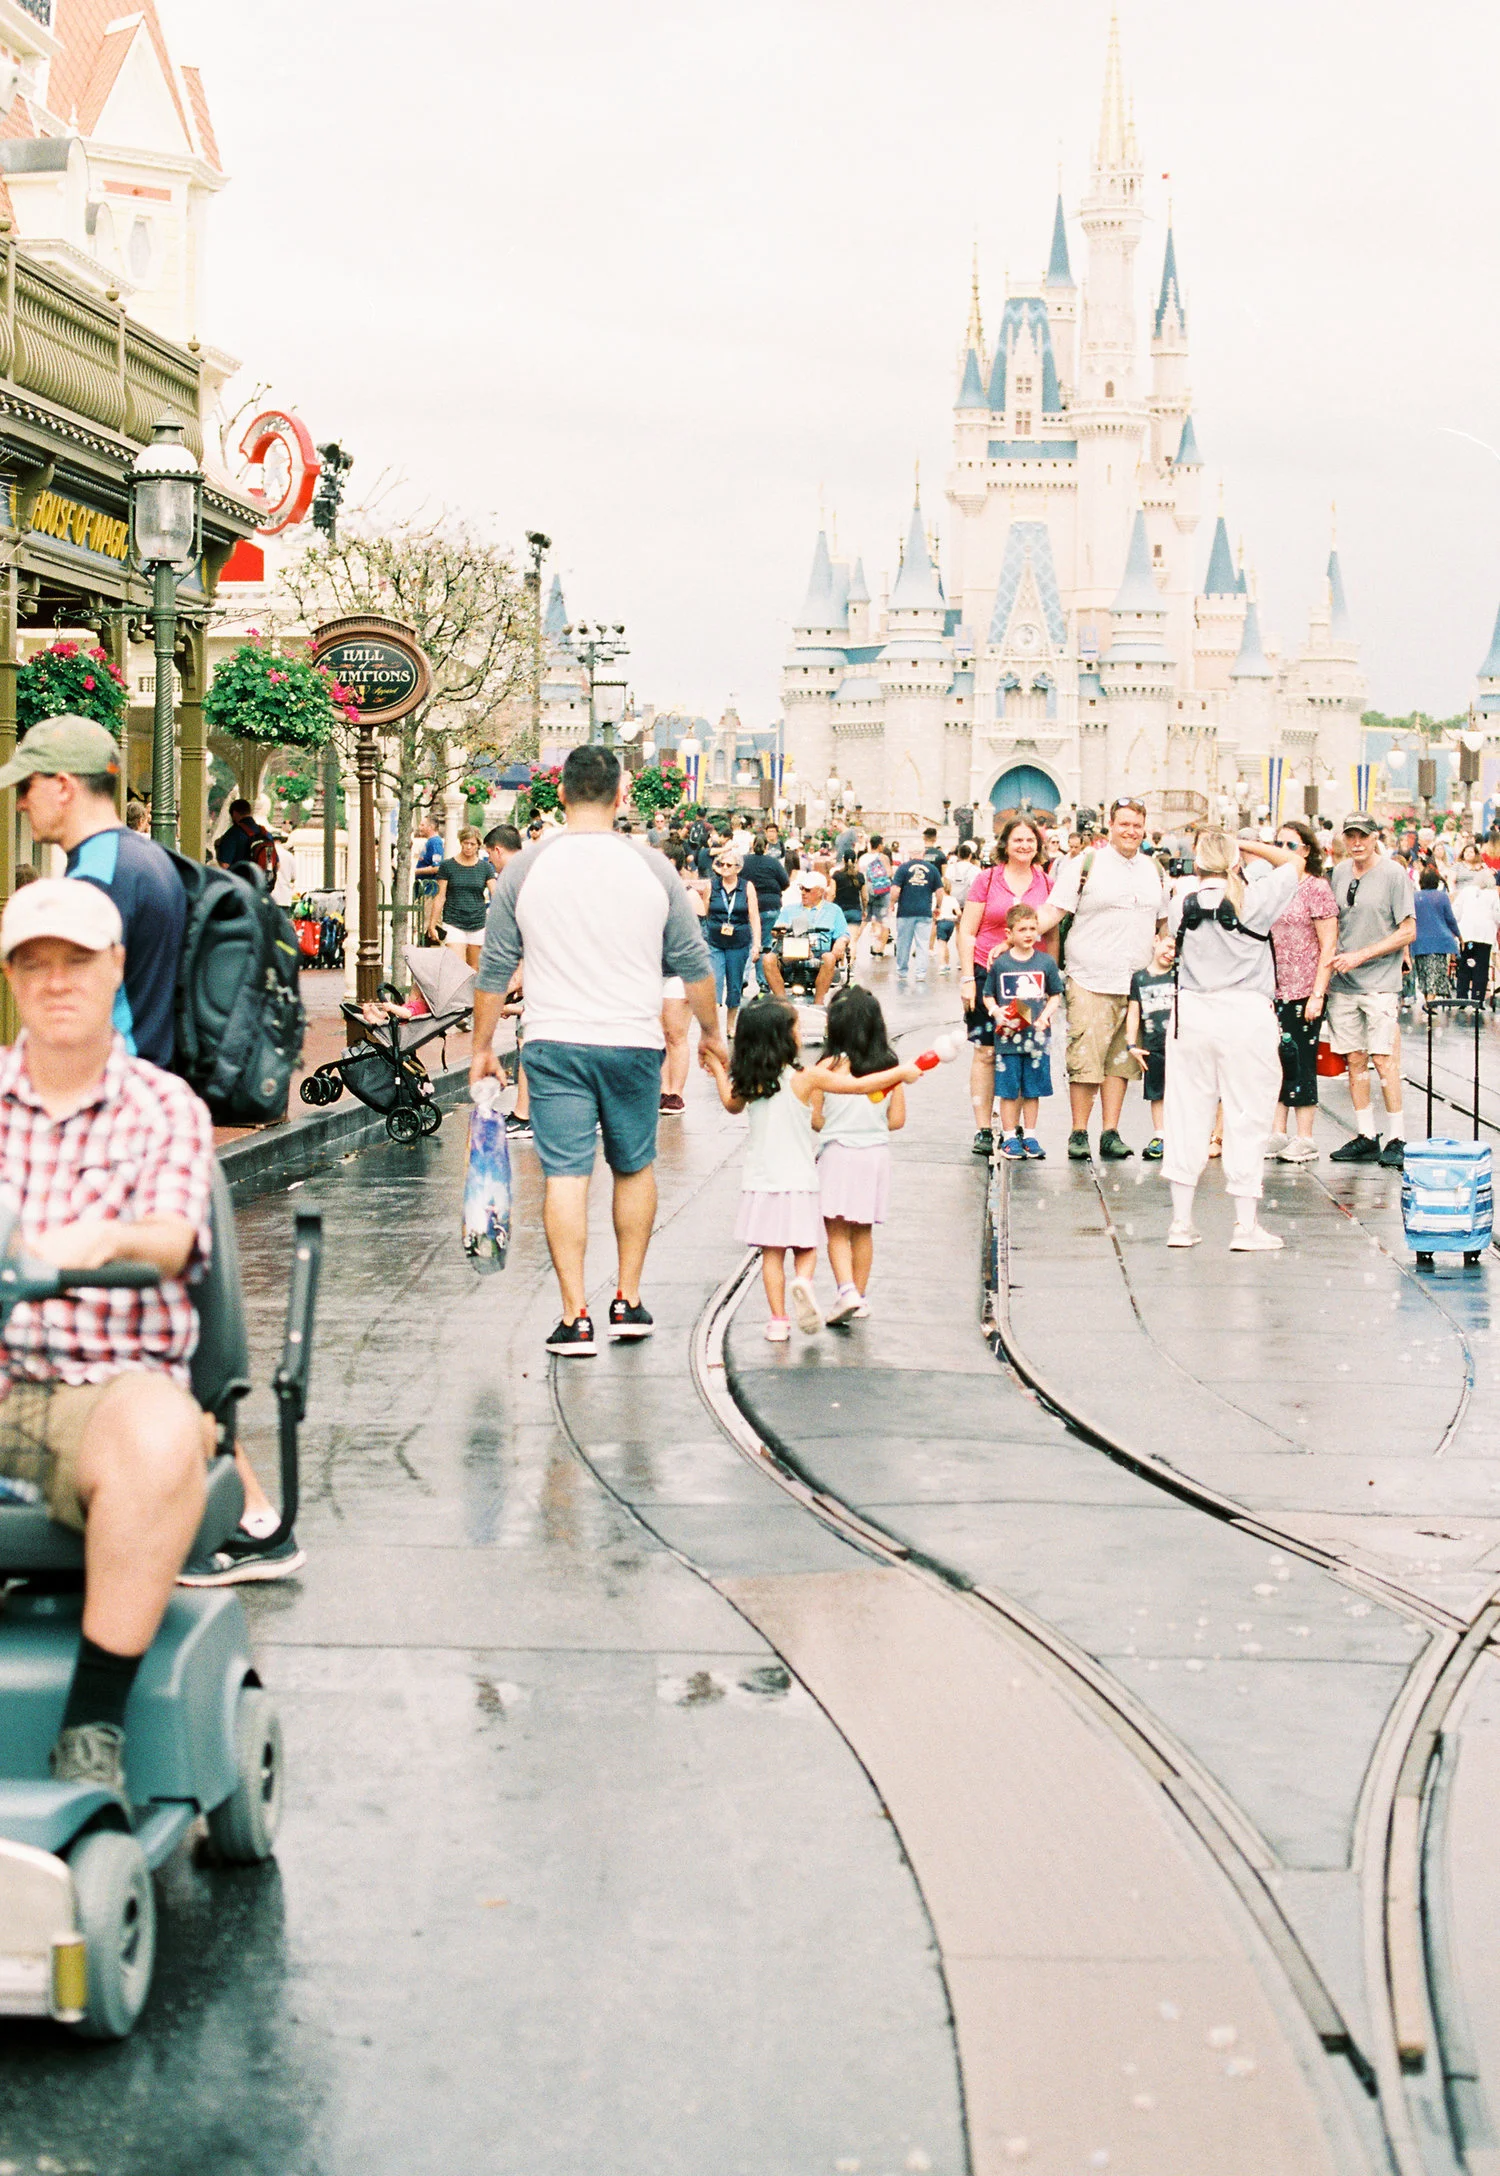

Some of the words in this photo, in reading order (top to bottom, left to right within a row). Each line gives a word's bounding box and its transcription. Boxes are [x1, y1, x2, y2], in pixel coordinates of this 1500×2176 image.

[30, 490, 77, 541] HOUSE
[72, 505, 95, 546] OF
[89, 513, 129, 561] MAGIC
[343, 649, 384, 661] HALL
[358, 660, 370, 671] of
[337, 670, 411, 682] AMPIONS
